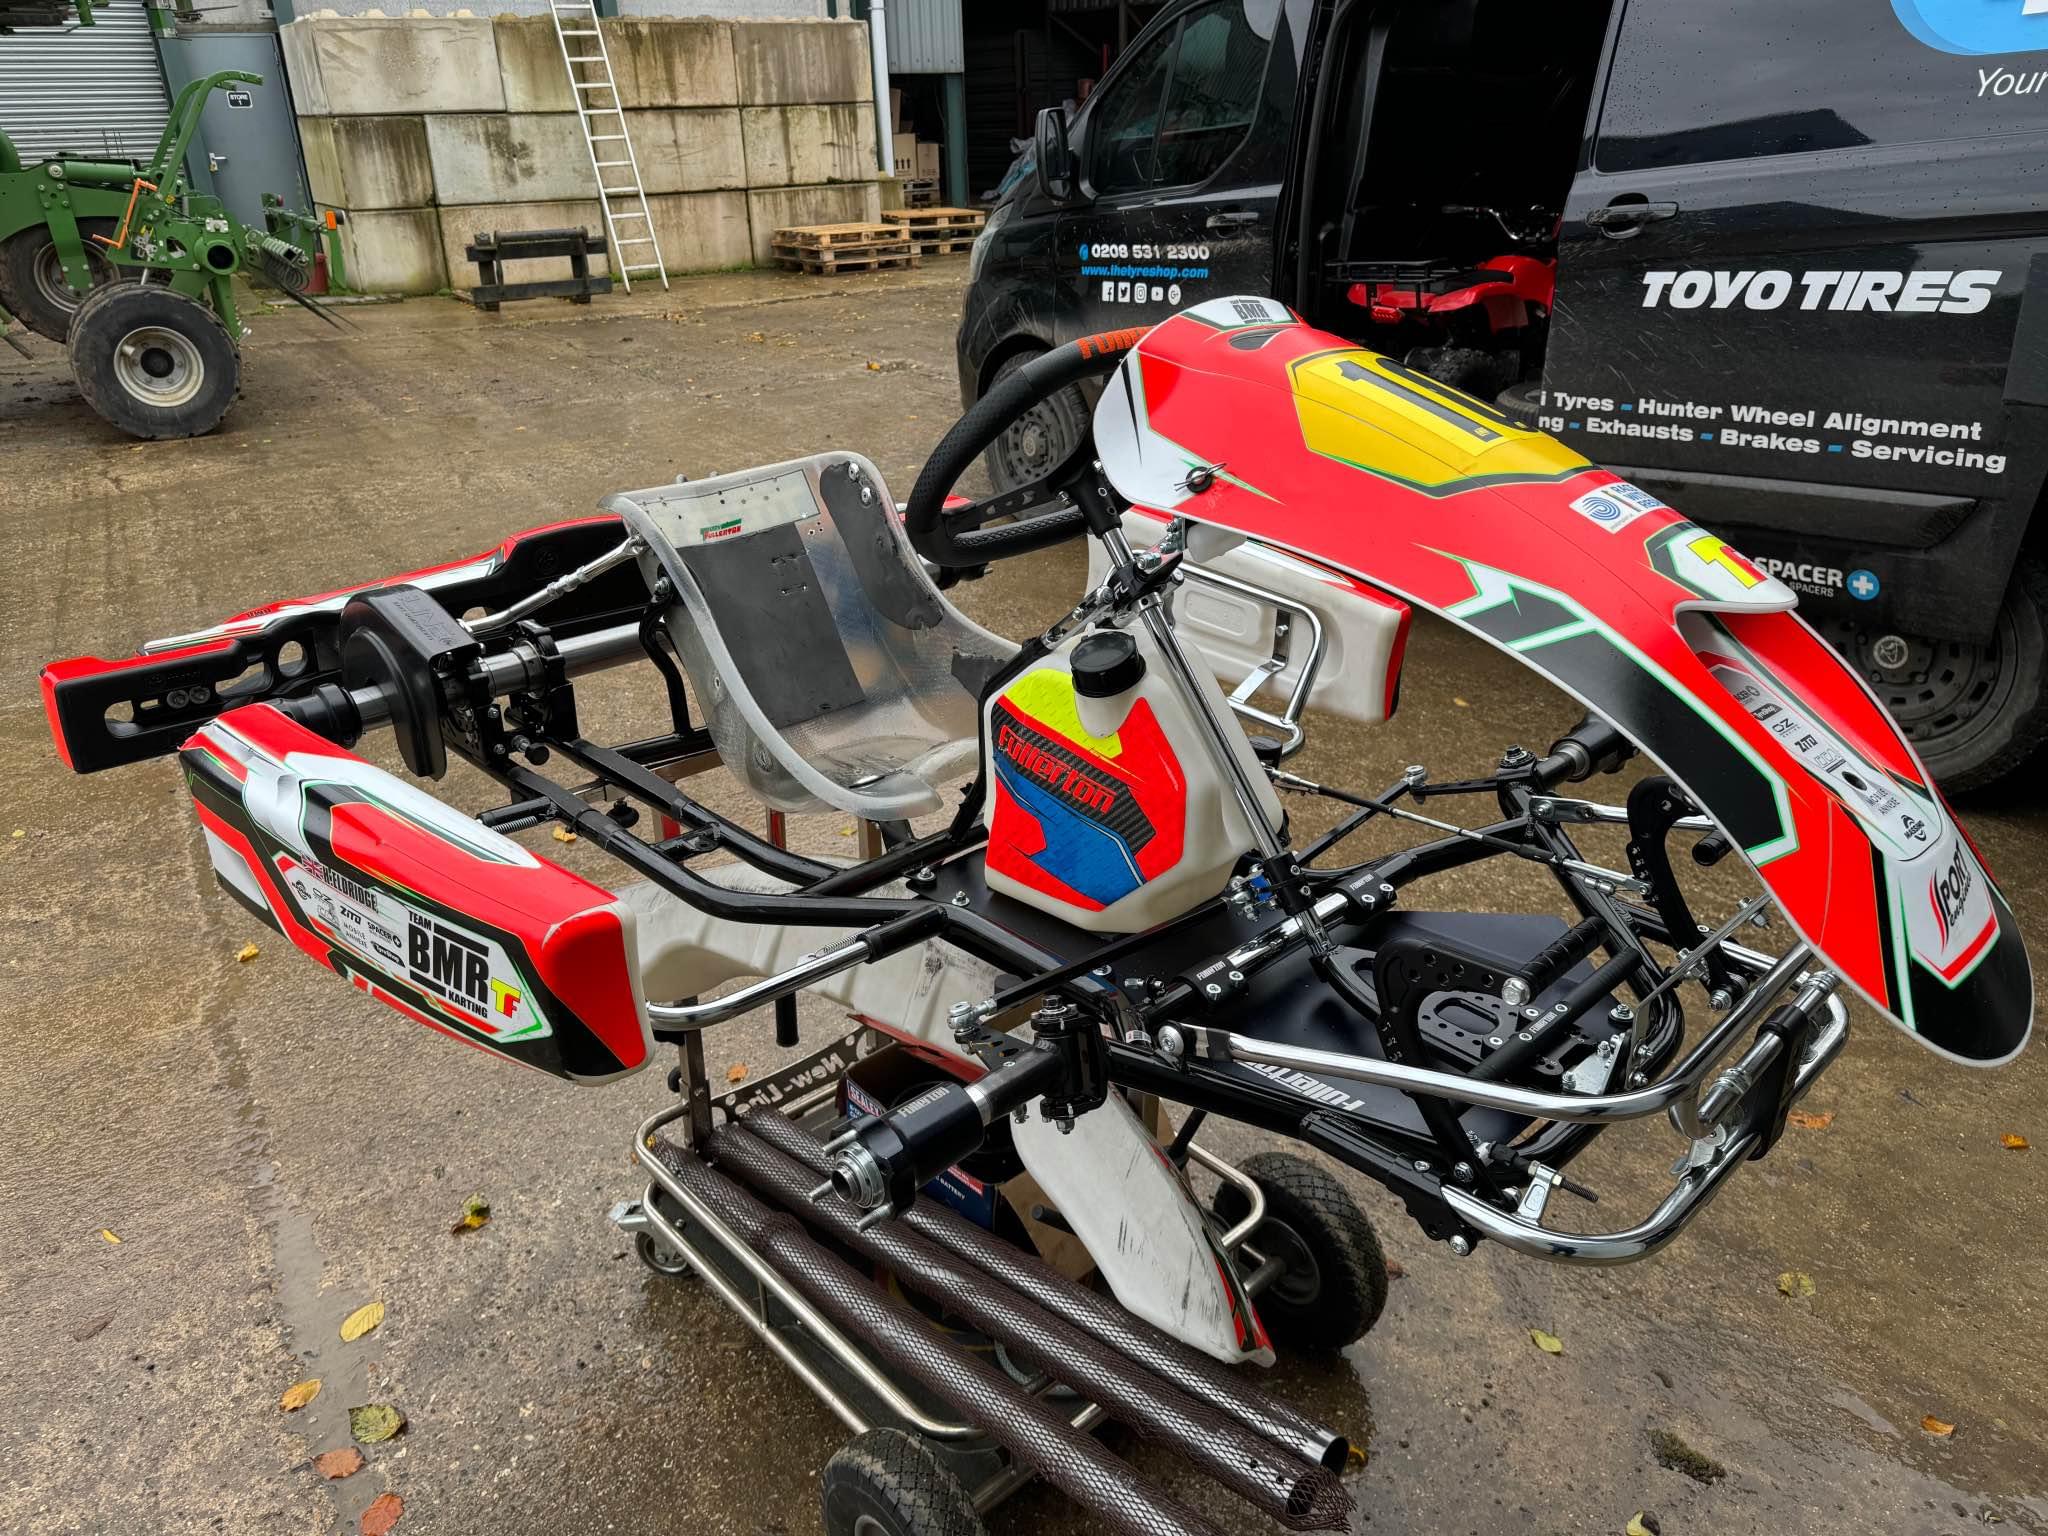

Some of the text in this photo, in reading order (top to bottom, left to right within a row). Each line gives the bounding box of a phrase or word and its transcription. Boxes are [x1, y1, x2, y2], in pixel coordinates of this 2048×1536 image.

[1091, 244, 1210, 260] 0208 531 2300
[1642, 270, 2003, 314] TOYO TIRES
[1554, 391, 1615, 412] Tyres
[1638, 398, 1723, 420] Hunter
[1731, 405, 1816, 429] Wheel
[1823, 411, 1983, 441] Alignment
[1586, 417, 1694, 442] Exhausts
[1720, 428, 1821, 454] Brakes
[1851, 440, 2007, 474] Servicing
[999, 724, 1118, 814] Fullerton
[408, 910, 432, 931] TEAM
[408, 923, 490, 1005] BMR
[448, 990, 488, 1019] KARTING
